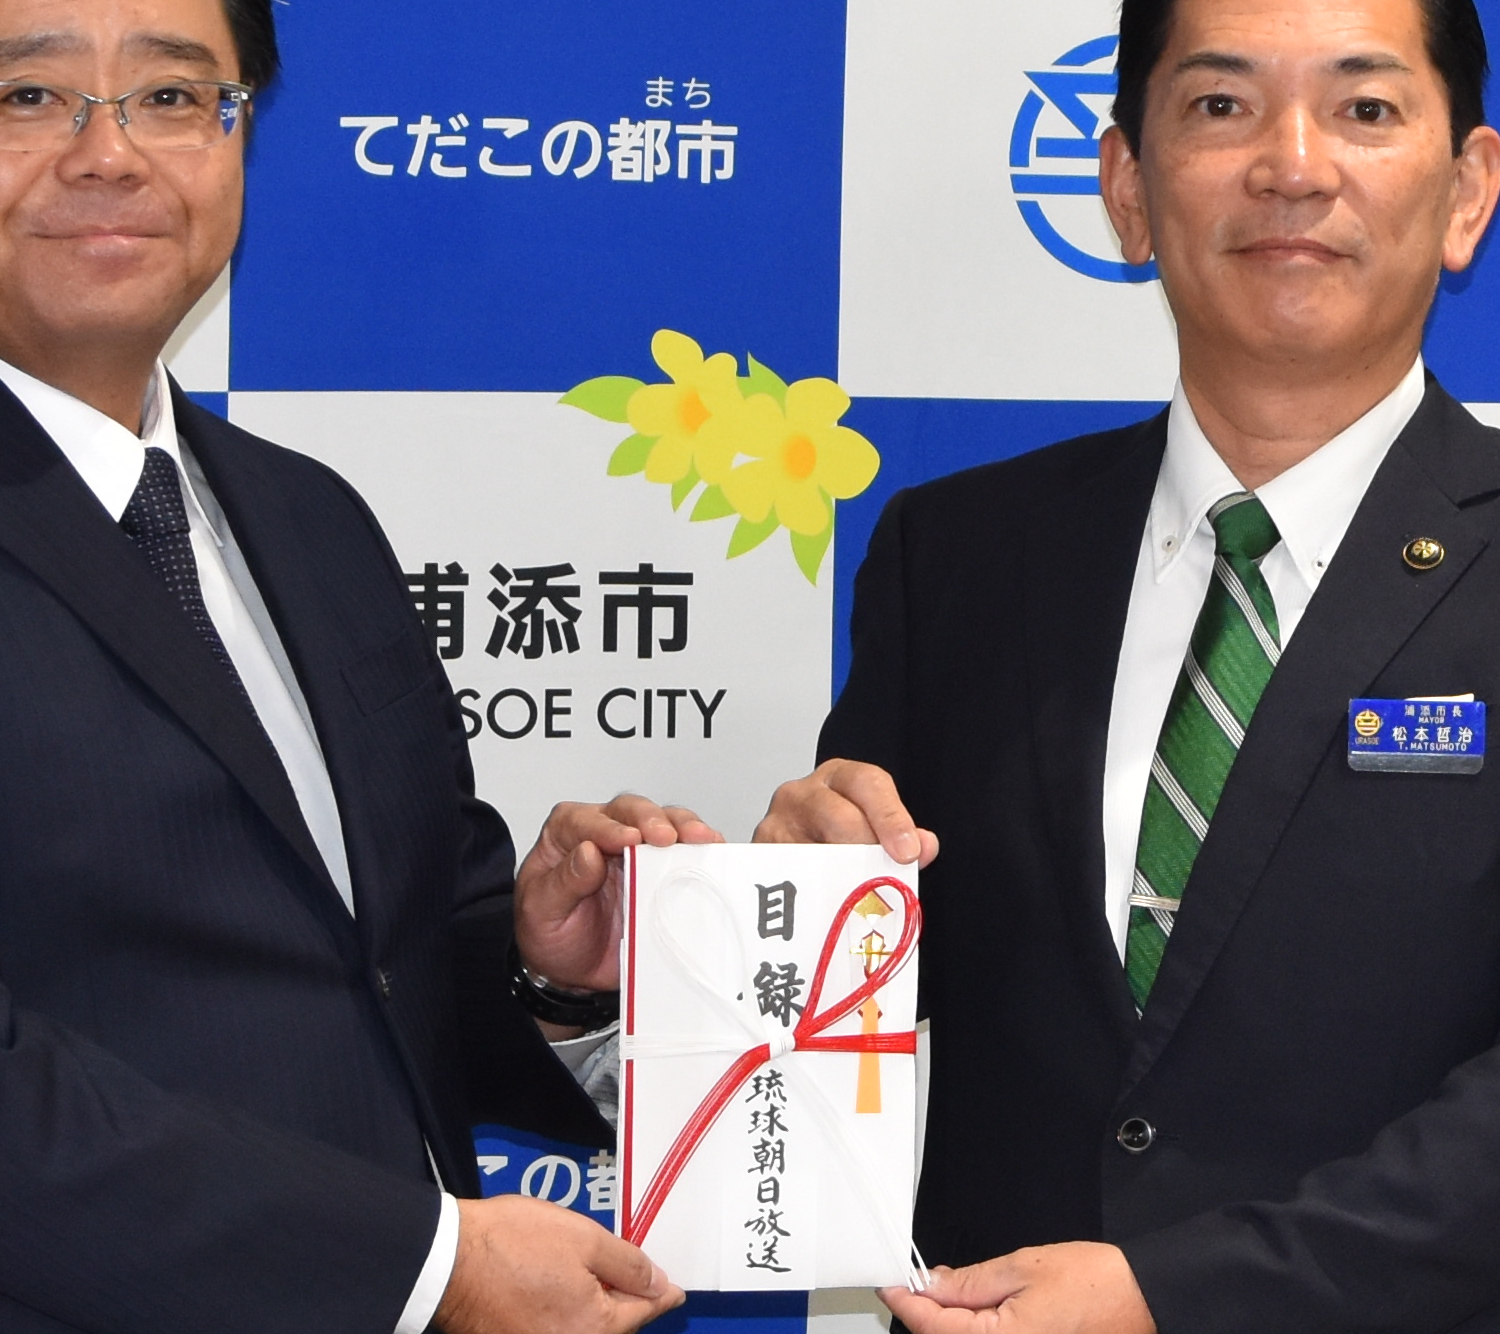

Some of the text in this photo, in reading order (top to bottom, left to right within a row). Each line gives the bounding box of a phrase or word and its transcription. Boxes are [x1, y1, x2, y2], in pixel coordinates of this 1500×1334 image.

[646, 77, 710, 108] まち
[340, 113, 738, 183] てだこの都市
[456, 688, 726, 739] SOE CITY
[1393, 726, 1473, 743] 松本哲治
[1399, 742, 1467, 751] T.MATSUMOTO
[755, 880, 804, 1027] 目録
[744, 1069, 792, 1273] 琉球朝日放送
